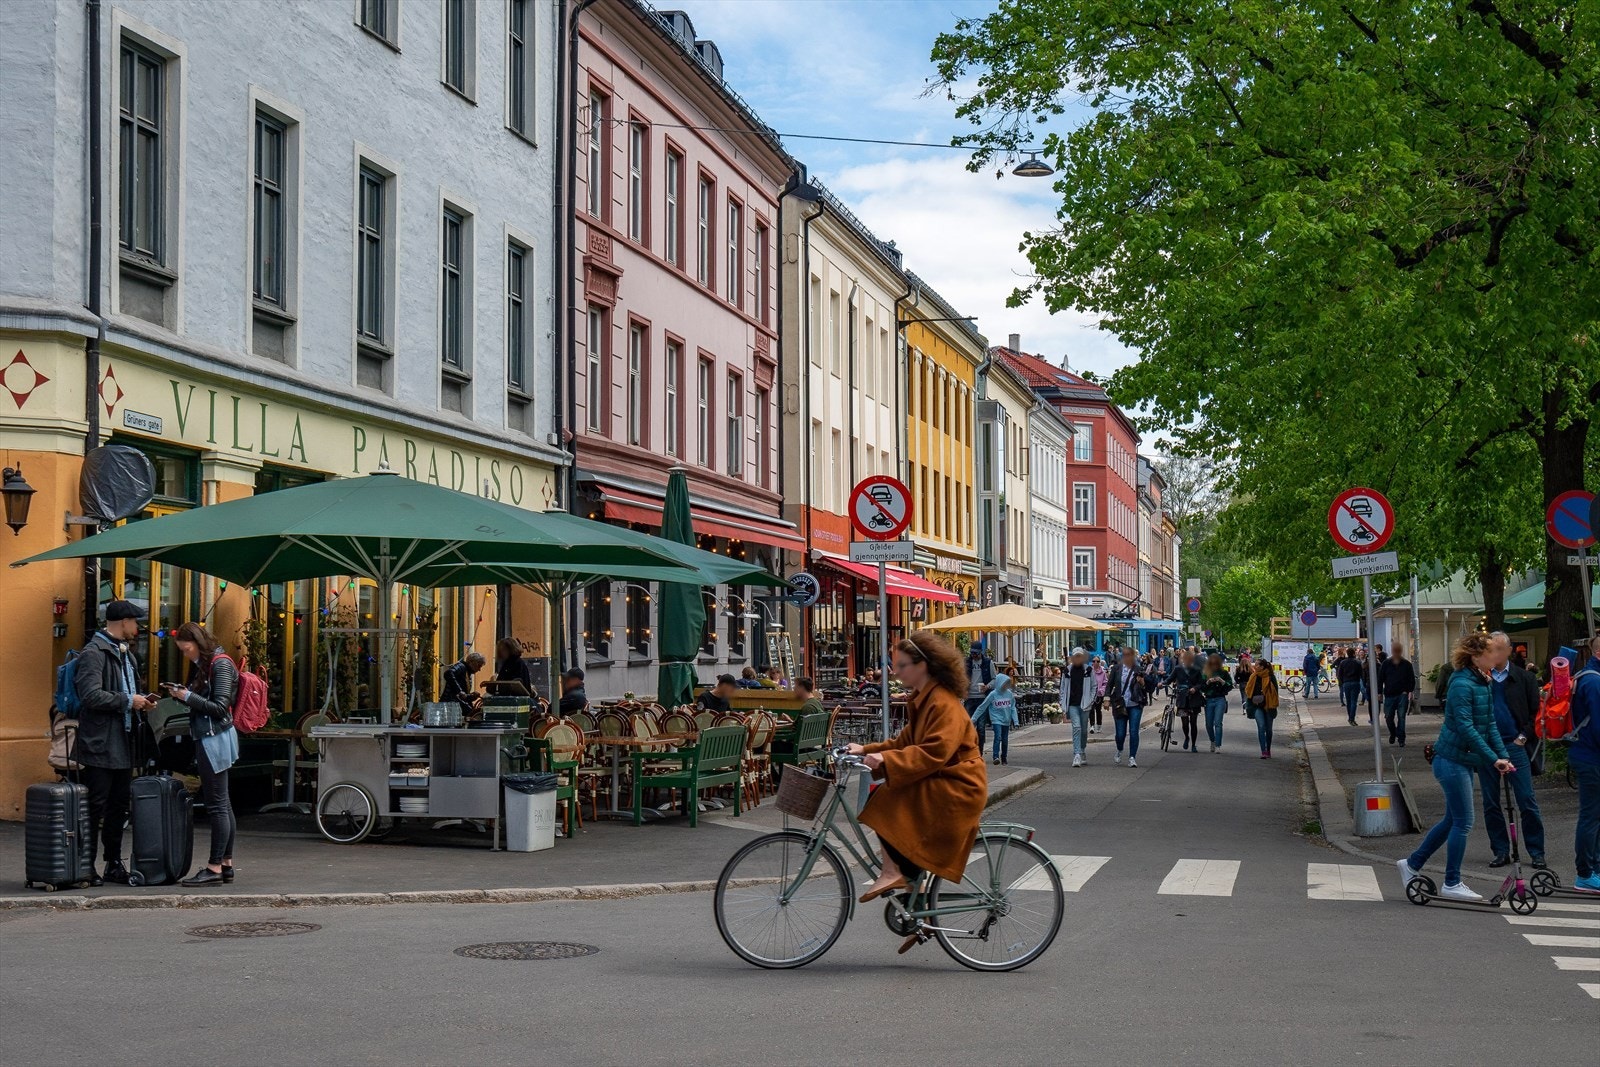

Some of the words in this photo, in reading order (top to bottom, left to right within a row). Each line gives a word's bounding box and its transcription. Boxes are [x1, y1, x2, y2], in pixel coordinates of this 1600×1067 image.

[127, 414, 146, 426] Grüners
[148, 421, 159, 430] gate
[169, 379, 309, 464] VILLA
[352, 425, 524, 505] PARADISO
[869, 543, 895, 552] Gjelder
[855, 553, 909, 561] gjennomkjøring
[1352, 556, 1378, 565] Gjelder
[1338, 564, 1394, 577] gjennomkjøring
